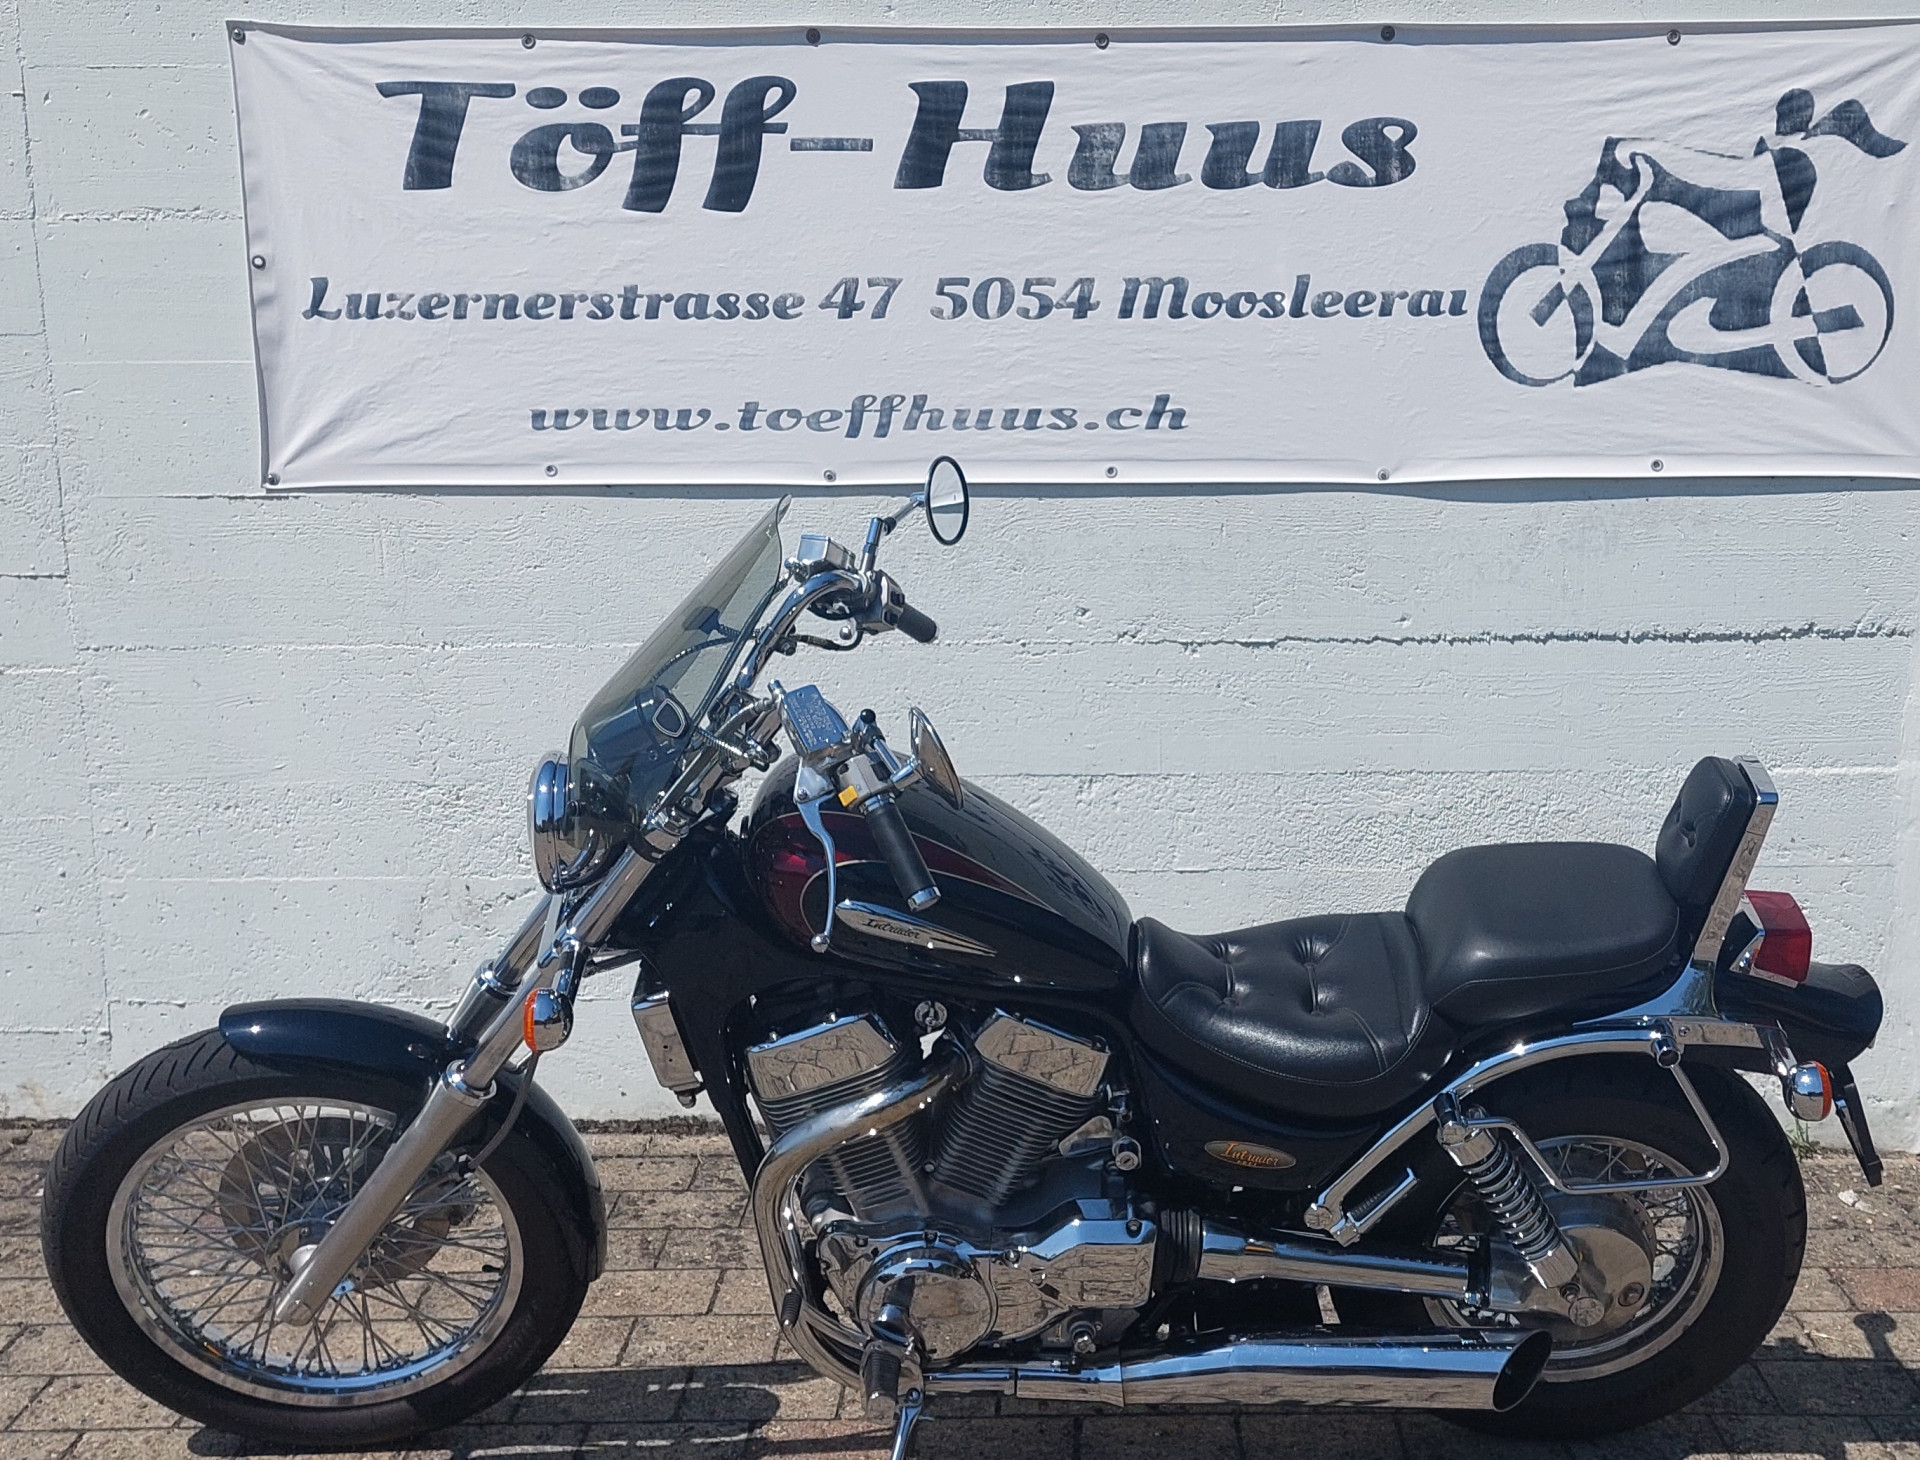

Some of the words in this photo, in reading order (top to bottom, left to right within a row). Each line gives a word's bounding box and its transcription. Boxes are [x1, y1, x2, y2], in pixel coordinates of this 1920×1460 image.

[375, 75, 1418, 214] Töff-Huus
[301, 276, 805, 321] Luzernerstrasse
[818, 276, 903, 320] 47
[929, 276, 1101, 320] 5054
[530, 393, 1189, 439] www.toeffhuus.ch
[861, 918, 921, 940] Intruder
